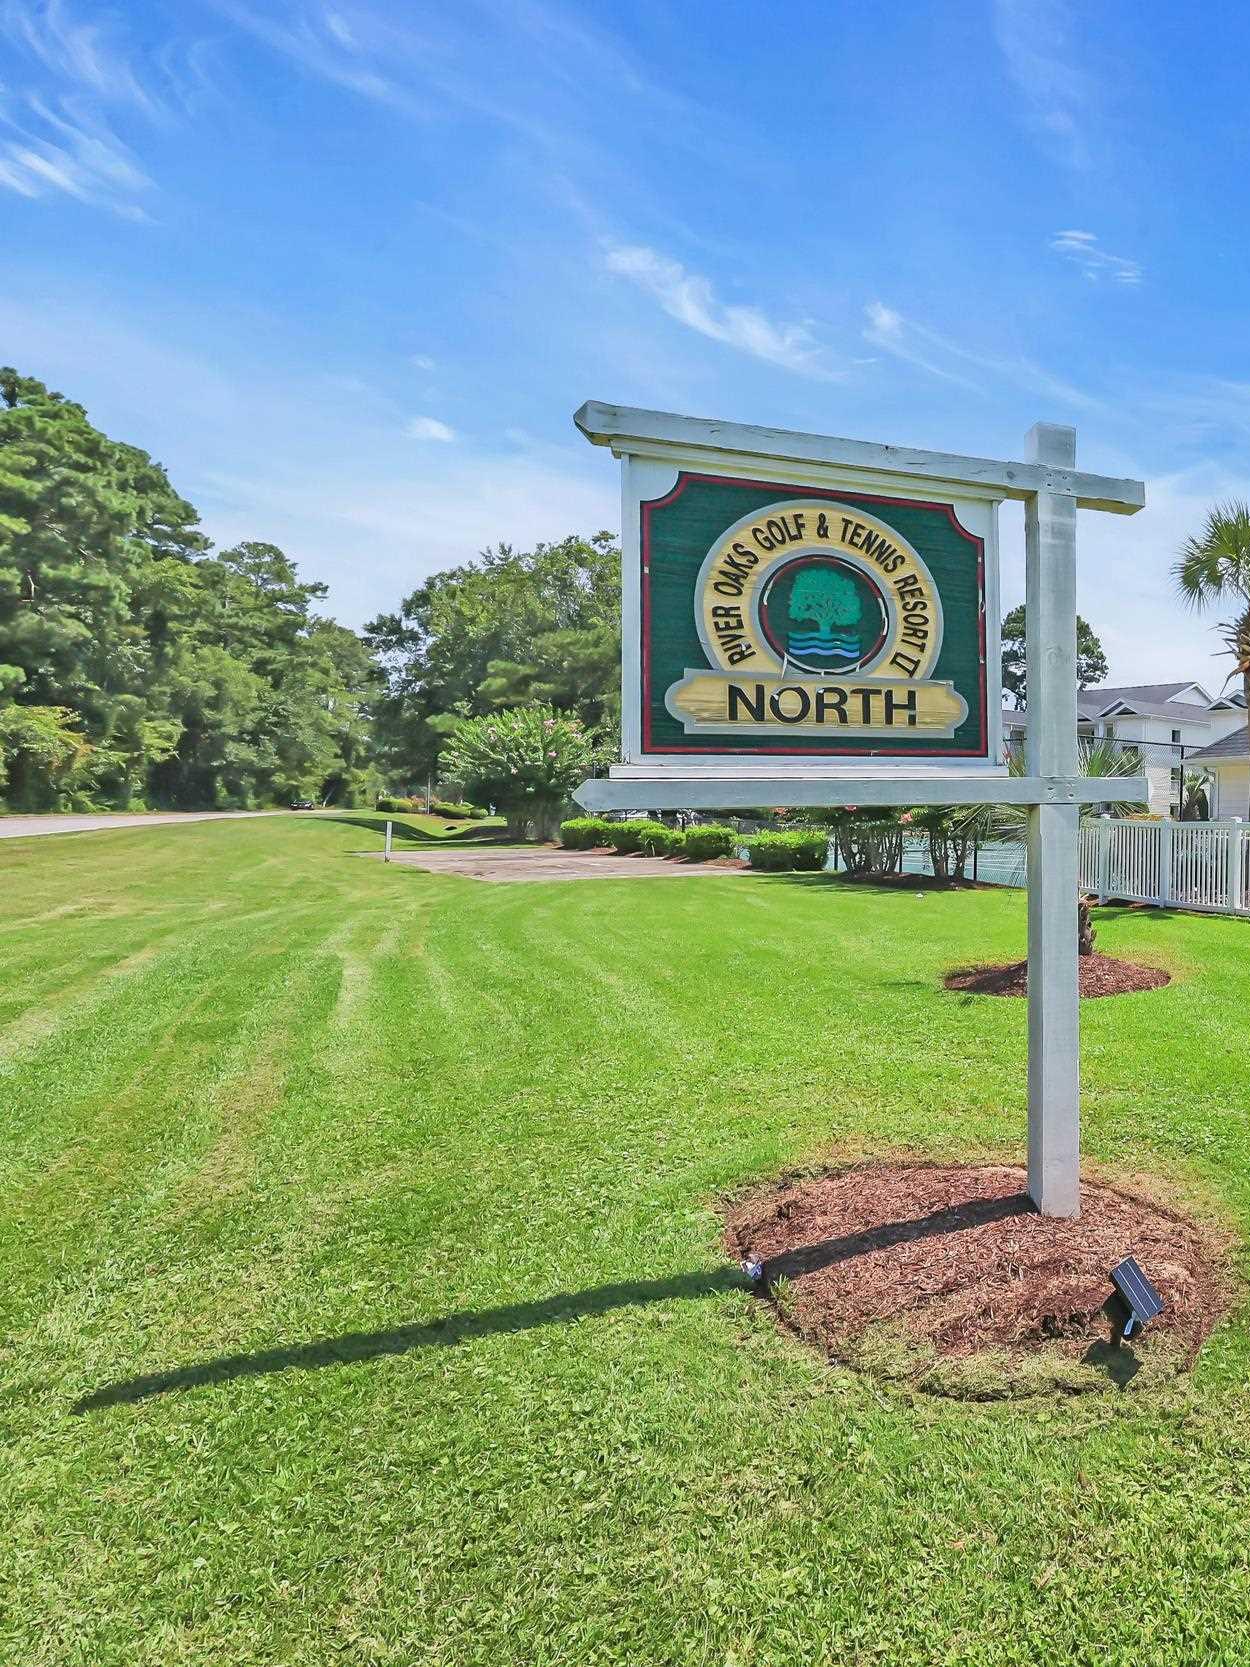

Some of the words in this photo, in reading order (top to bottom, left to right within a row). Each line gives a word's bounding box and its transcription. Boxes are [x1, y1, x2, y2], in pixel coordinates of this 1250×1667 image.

[751, 513, 806, 551] GOLF
[816, 512, 829, 539] &
[840, 517, 905, 574] TENNIS
[713, 542, 759, 597] OAKS
[711, 605, 757, 666] RIVER
[893, 573, 929, 654] RESORT
[728, 683, 916, 726] NORTH
